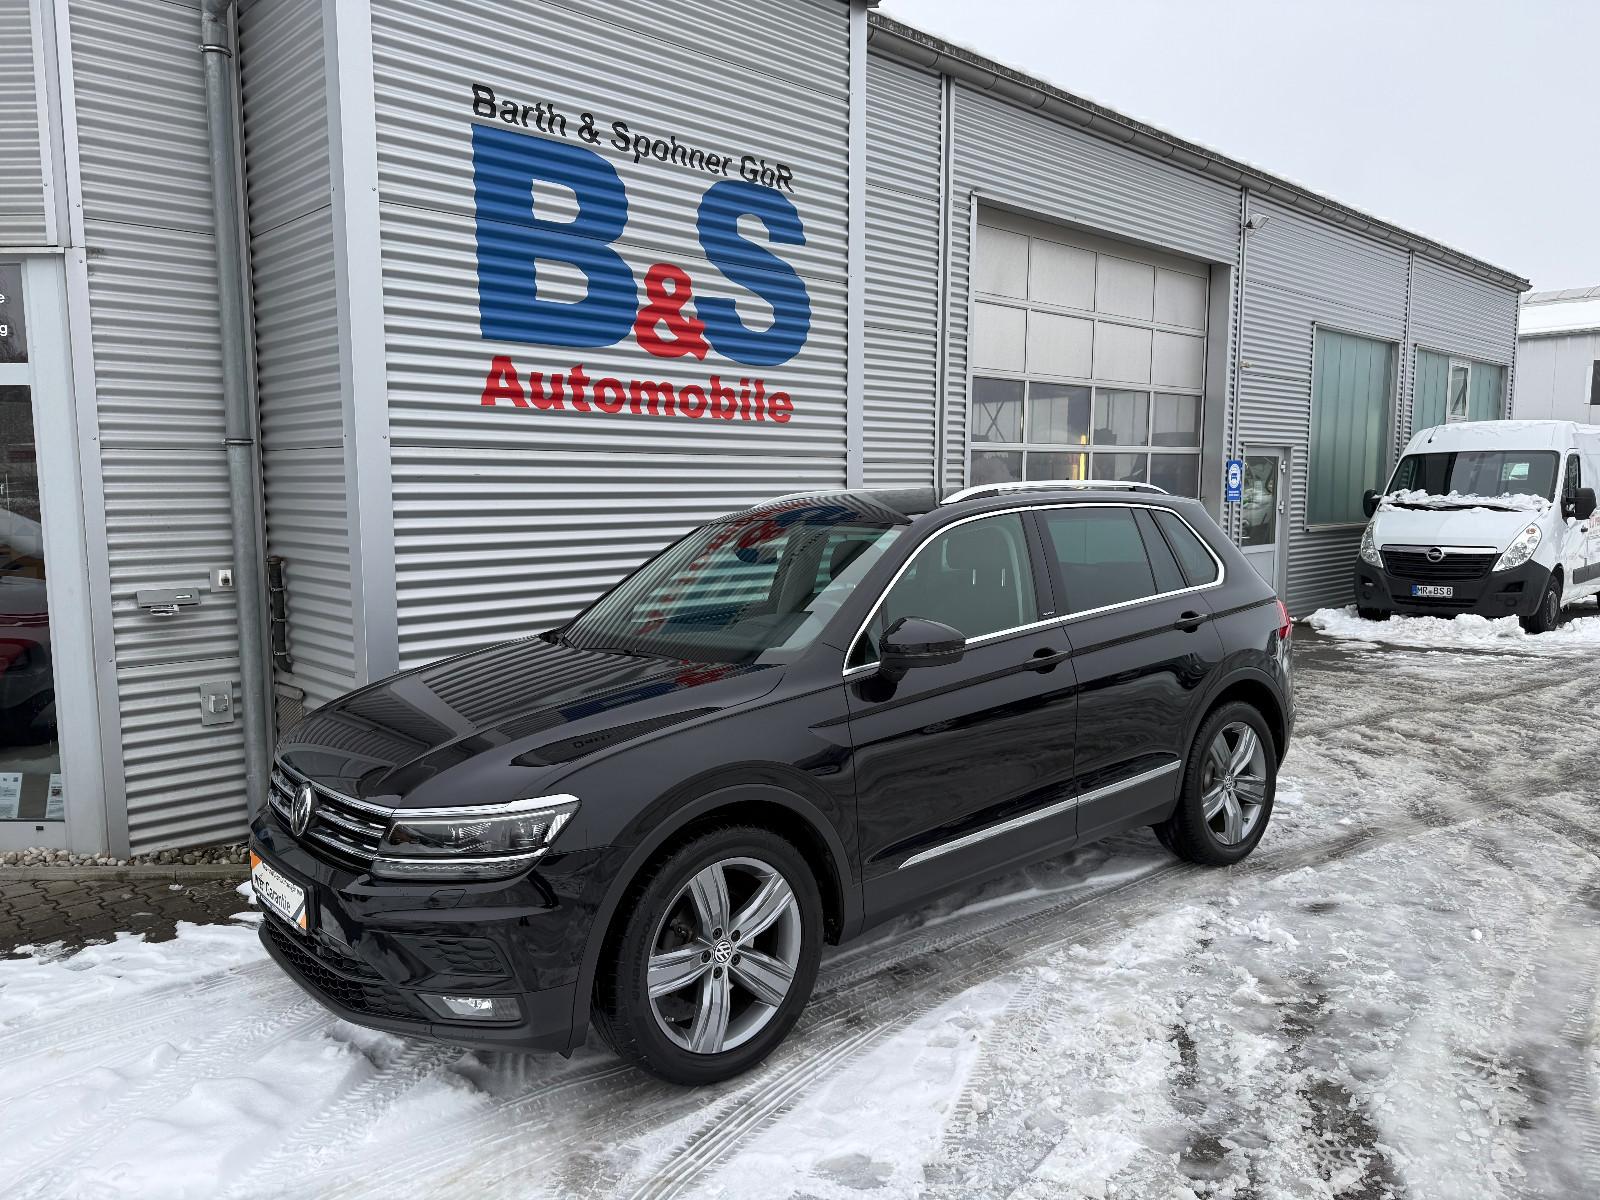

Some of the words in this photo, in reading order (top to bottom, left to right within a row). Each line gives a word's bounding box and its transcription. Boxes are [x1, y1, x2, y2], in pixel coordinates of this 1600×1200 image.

[471, 83, 567, 137] Barth
[578, 112, 602, 145] &
[611, 121, 732, 177] Spohner
[739, 155, 794, 193] GbR
[481, 355, 795, 424] Automobile
